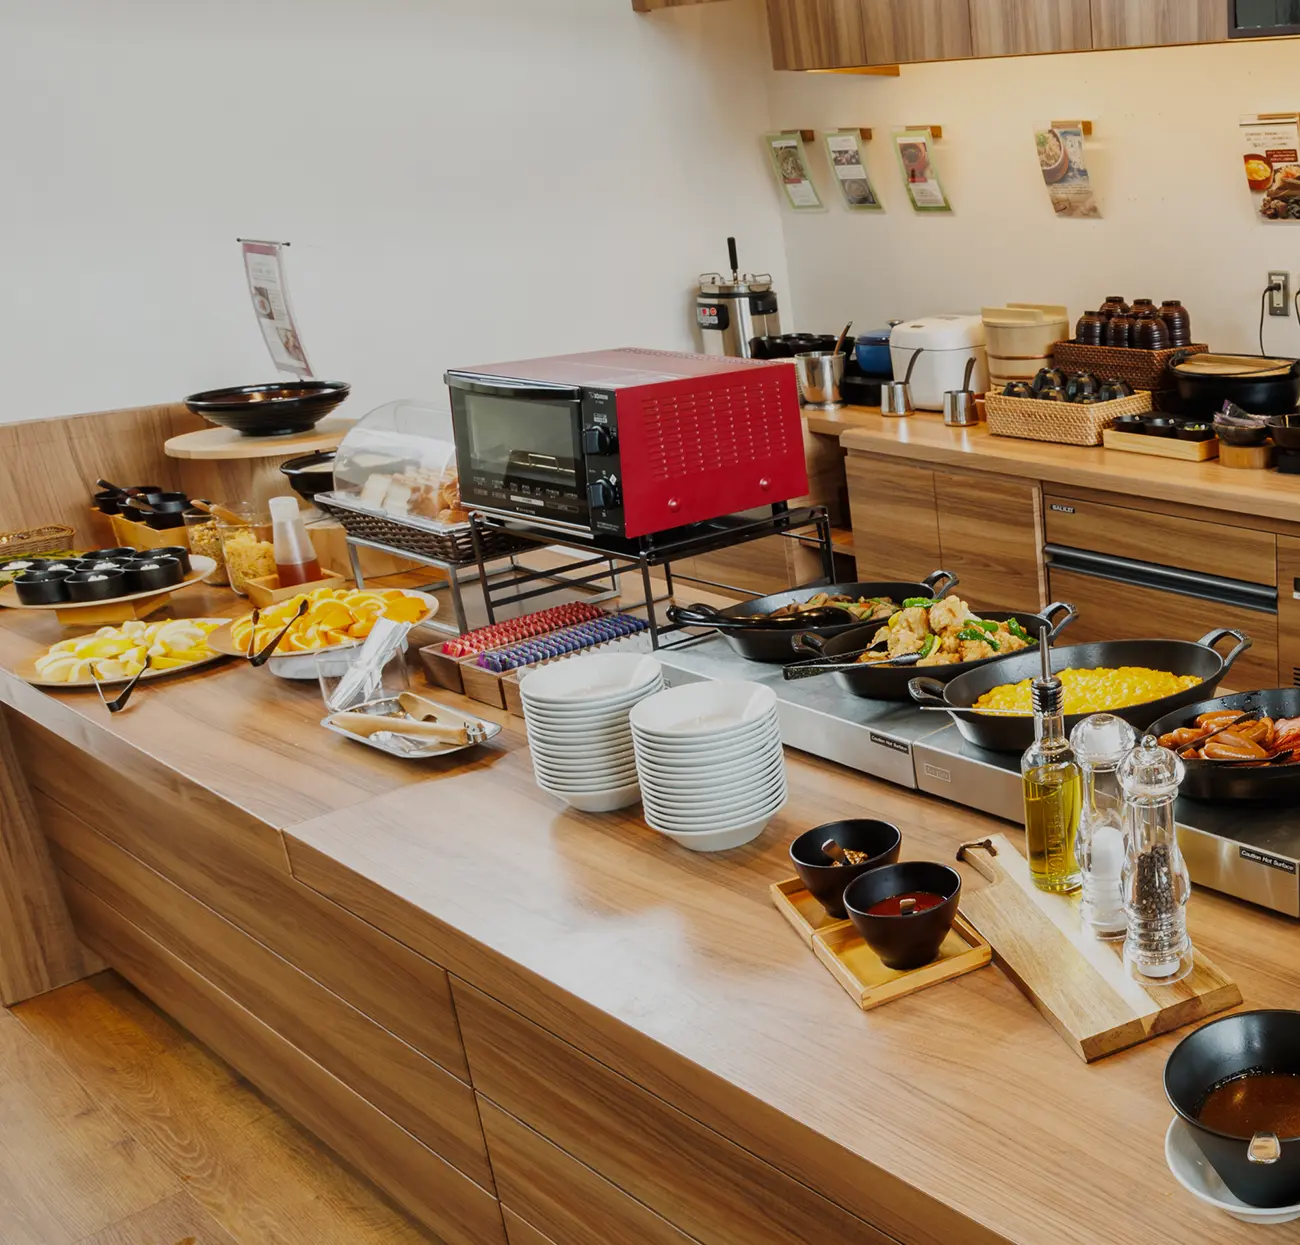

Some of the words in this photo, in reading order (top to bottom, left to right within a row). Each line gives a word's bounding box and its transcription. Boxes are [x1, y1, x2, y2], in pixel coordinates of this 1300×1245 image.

[871, 735, 886, 745] Caution
[893, 742, 908, 752] Surface
[1241, 849, 1262, 861] Caution
[1262, 856, 1273, 864] Hot
[1273, 860, 1295, 871] Surface
